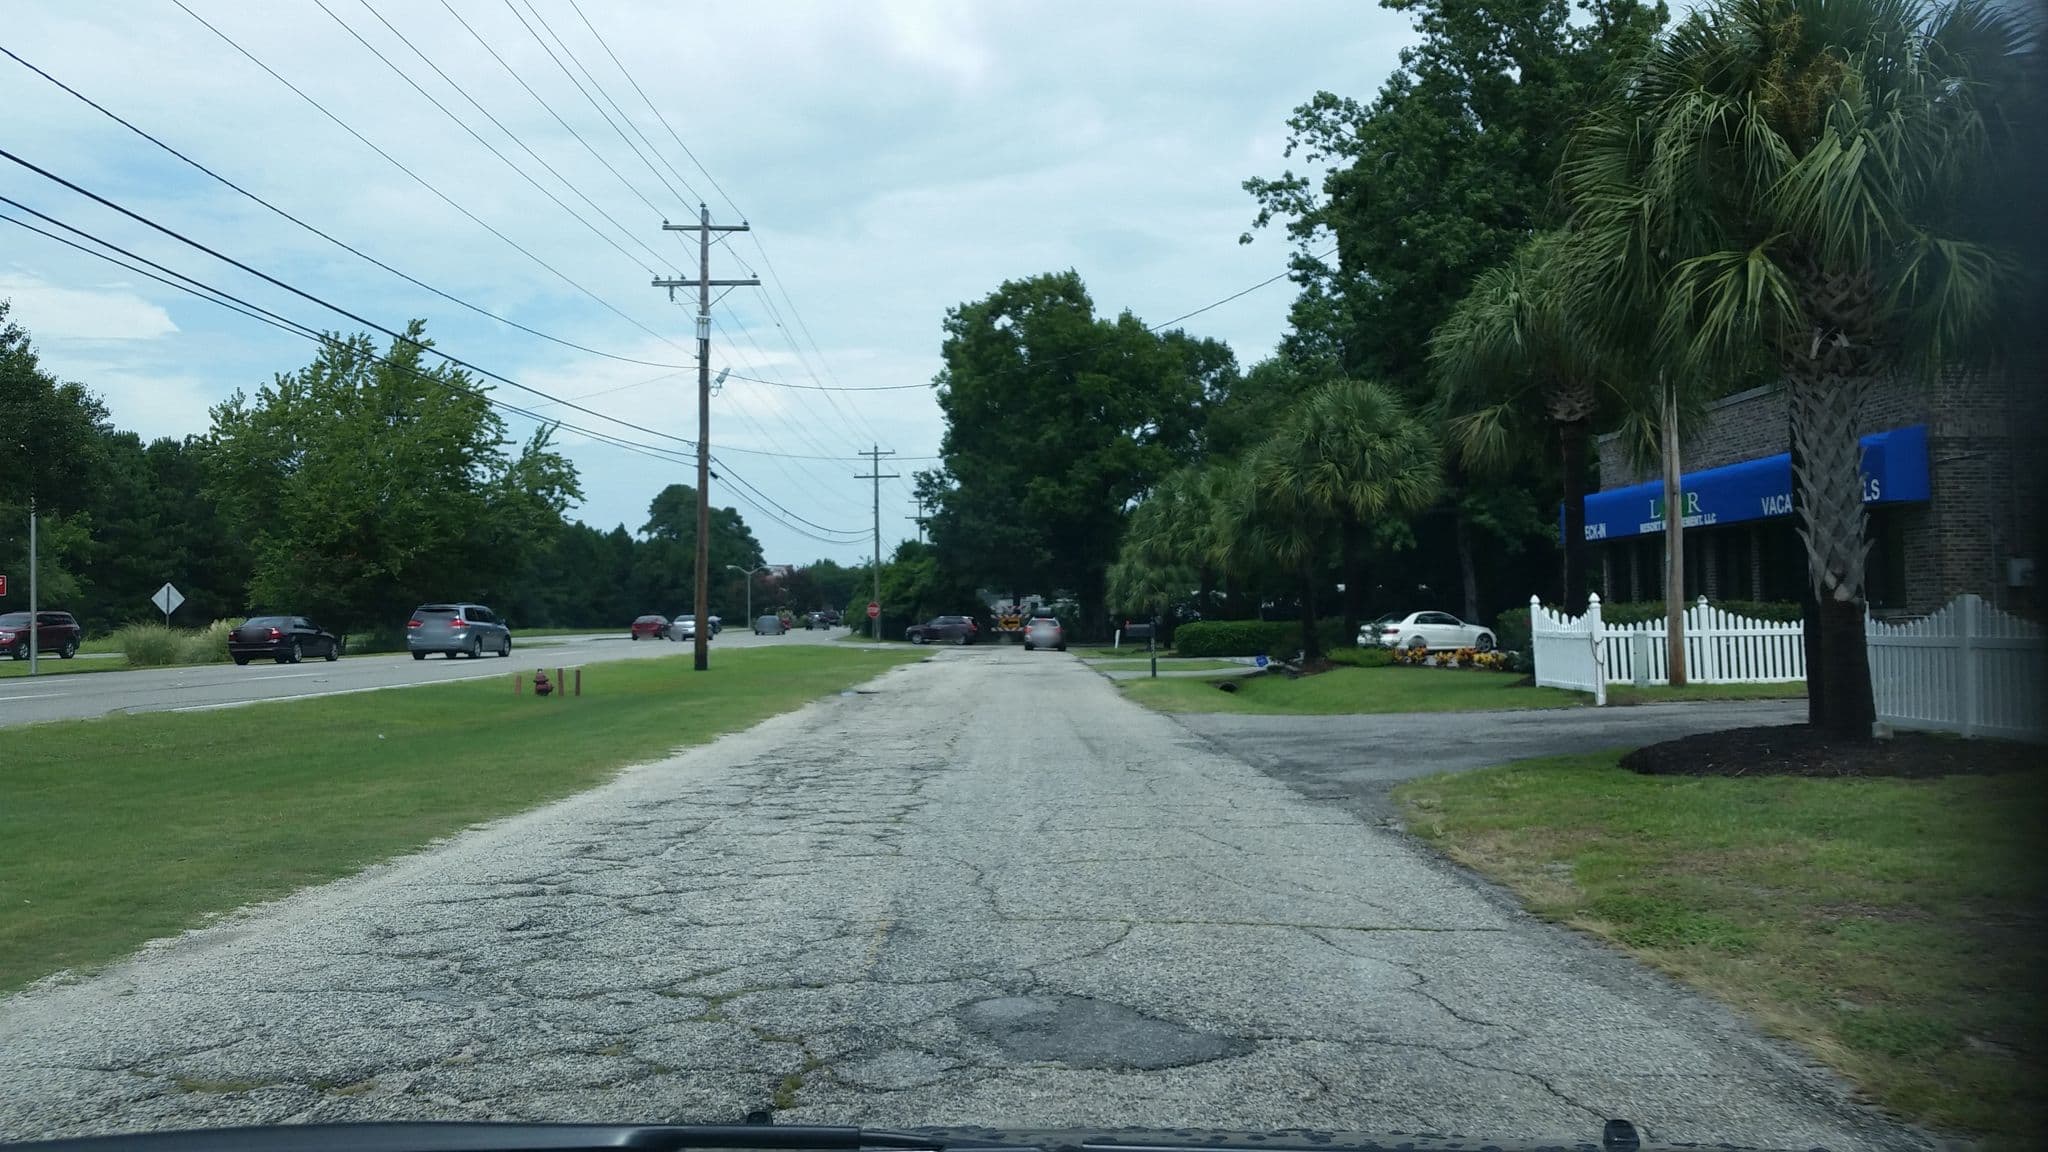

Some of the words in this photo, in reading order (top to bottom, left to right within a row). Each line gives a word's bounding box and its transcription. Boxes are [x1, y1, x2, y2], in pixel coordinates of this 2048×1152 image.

[1863, 478, 1880, 501] LS
[1761, 493, 1793, 516] VACA
[1584, 523, 1606, 540] ECK-IN
